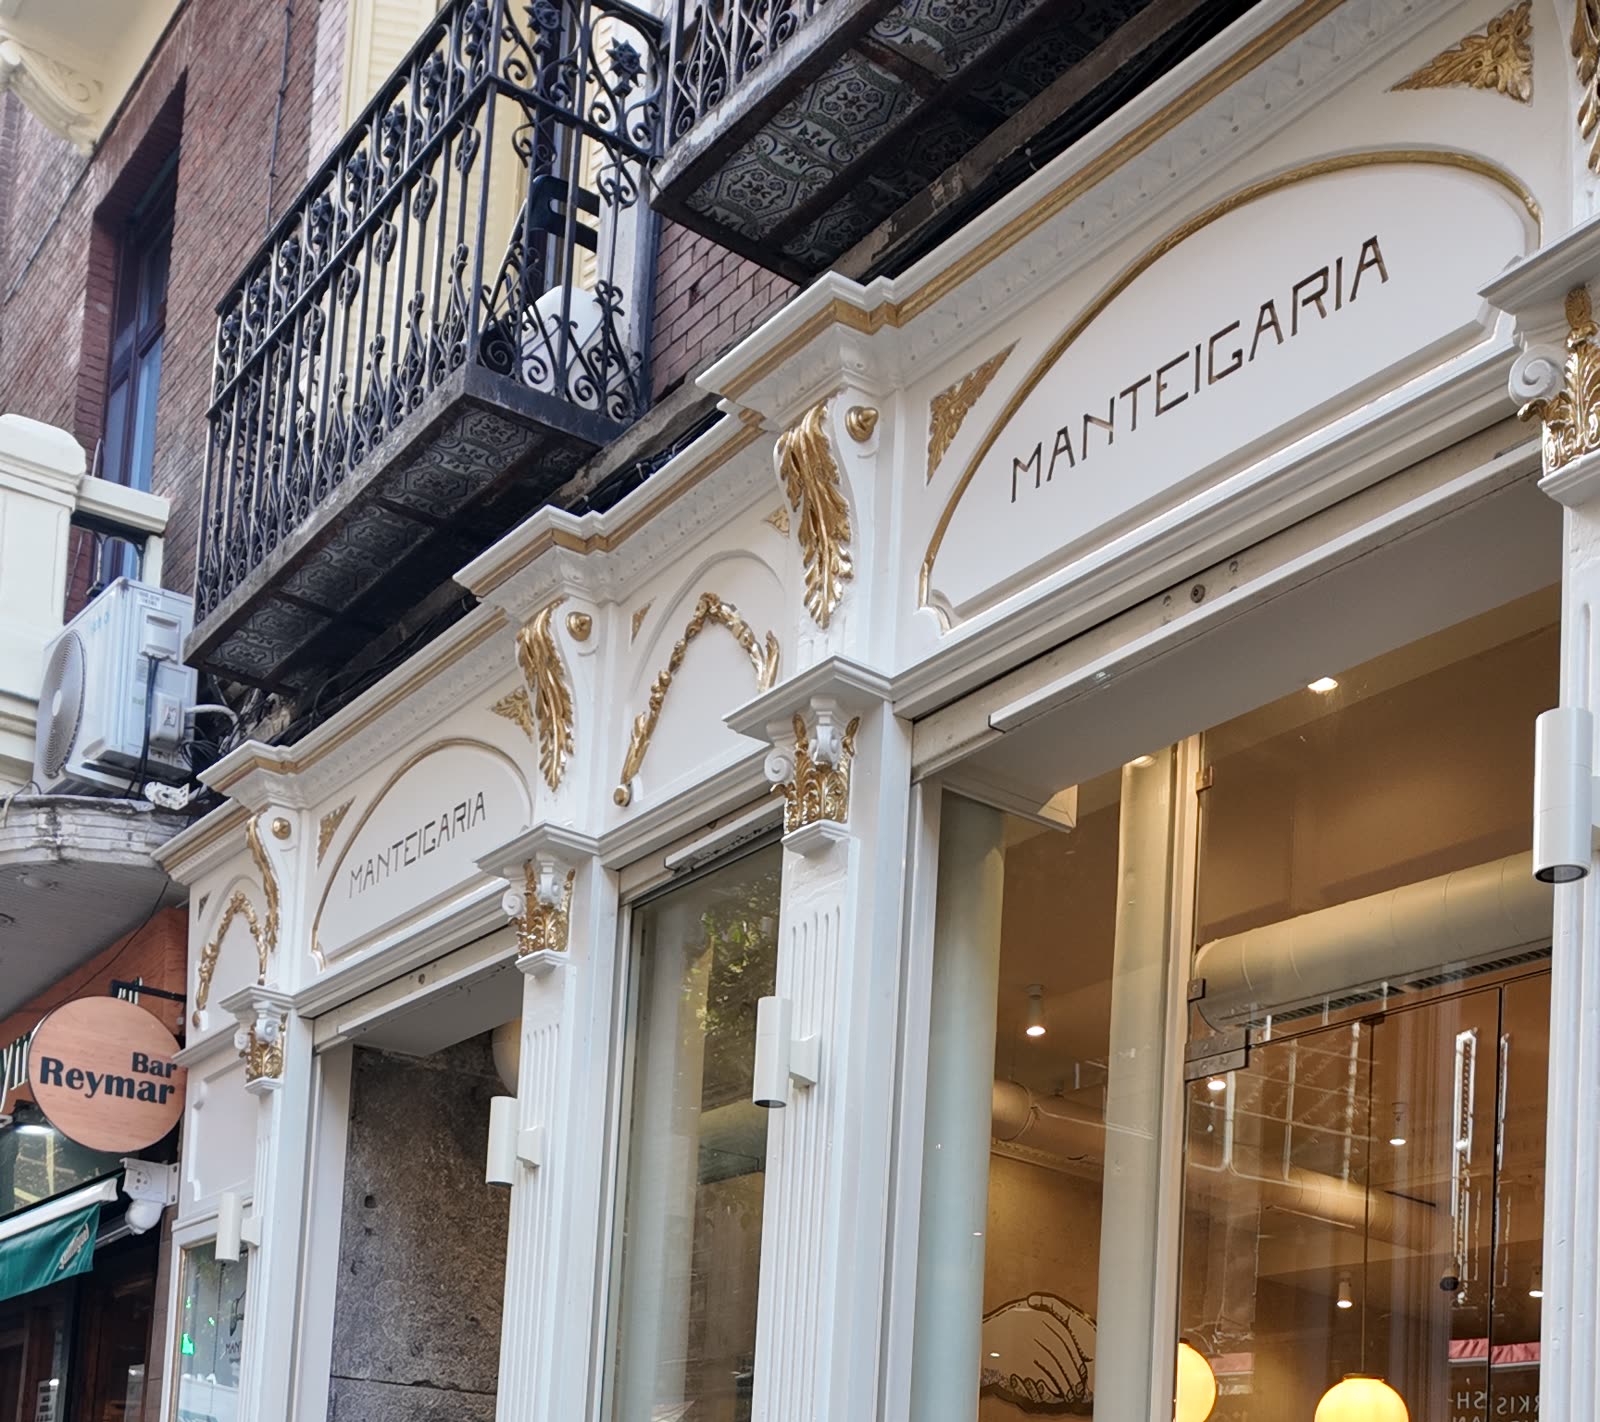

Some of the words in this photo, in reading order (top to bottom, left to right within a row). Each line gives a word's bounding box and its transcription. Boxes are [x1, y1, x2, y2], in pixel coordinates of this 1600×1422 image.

[1010, 235, 1389, 503] MANTEIGARIA
[349, 791, 486, 899] MANTEIGARIA
[39, 1056, 175, 1105] Reymar
[132, 1052, 177, 1079] Bar
